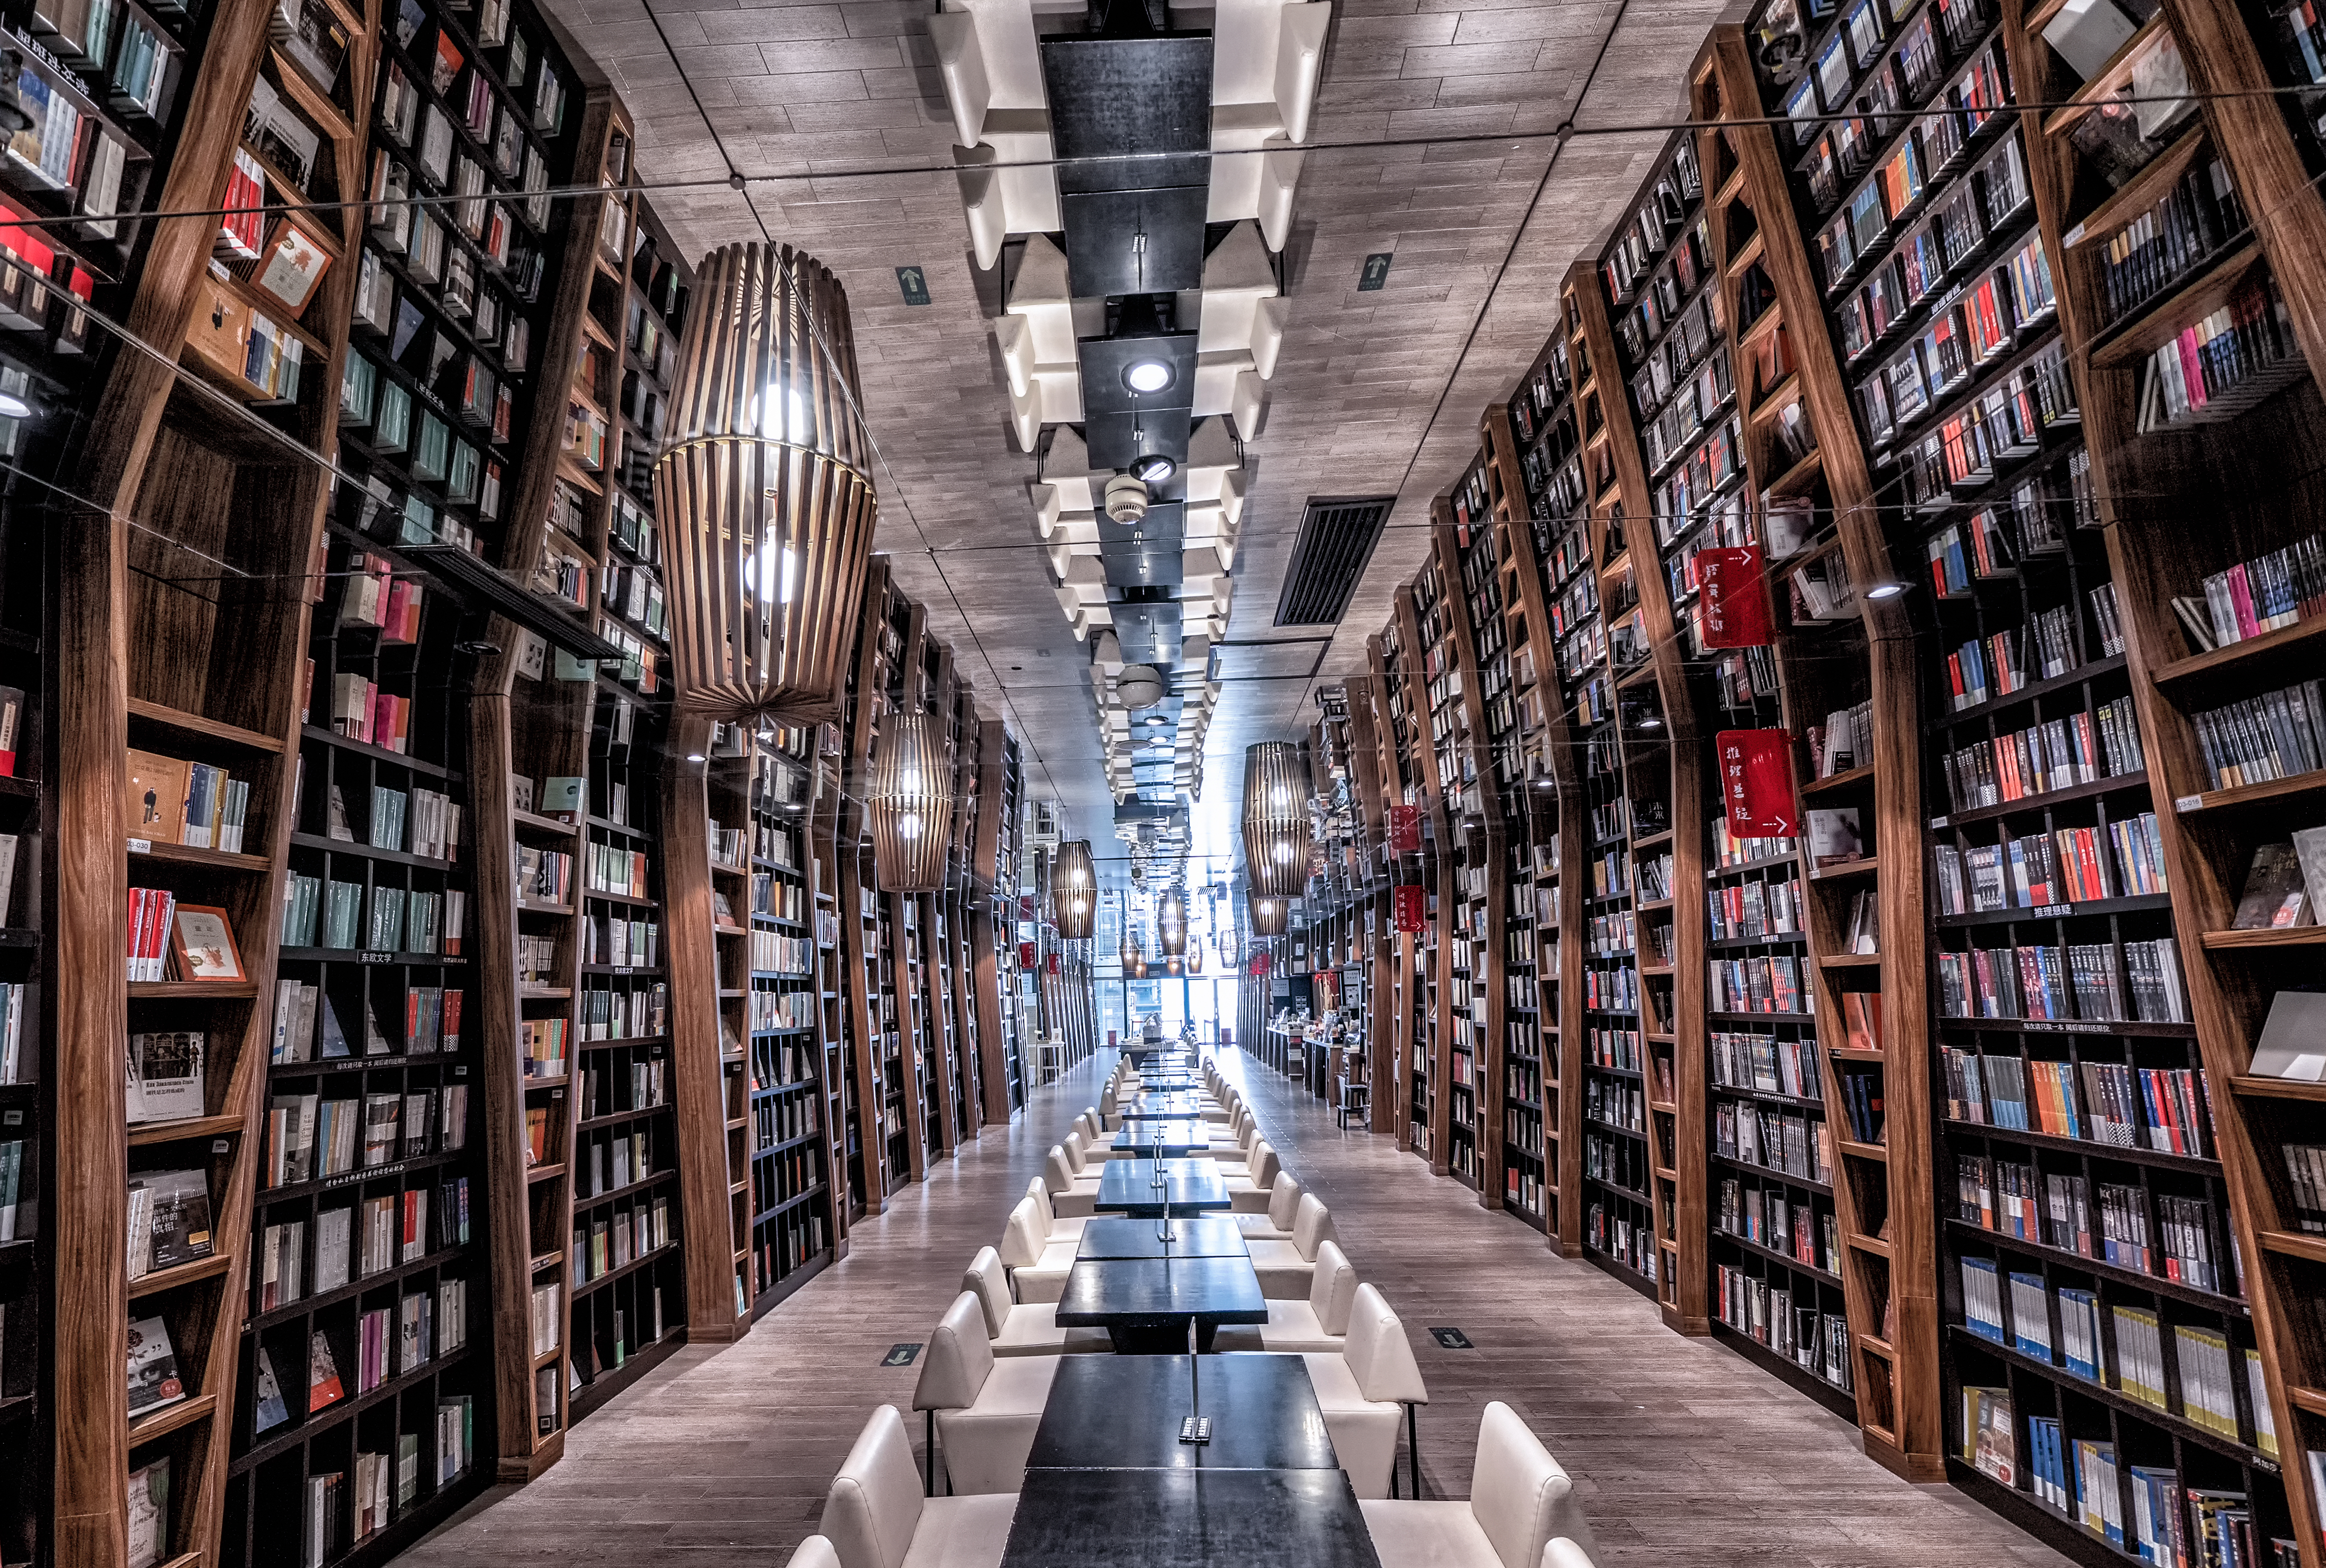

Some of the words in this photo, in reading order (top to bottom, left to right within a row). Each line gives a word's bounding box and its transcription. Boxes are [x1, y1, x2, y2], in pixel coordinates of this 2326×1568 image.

[1726, 747, 1751, 820] 推理悬疑
[2178, 798, 2199, 808] 03-016
[2034, 904, 2071, 918] 推理悬疑
[362, 953, 392, 962] 东欧文学
